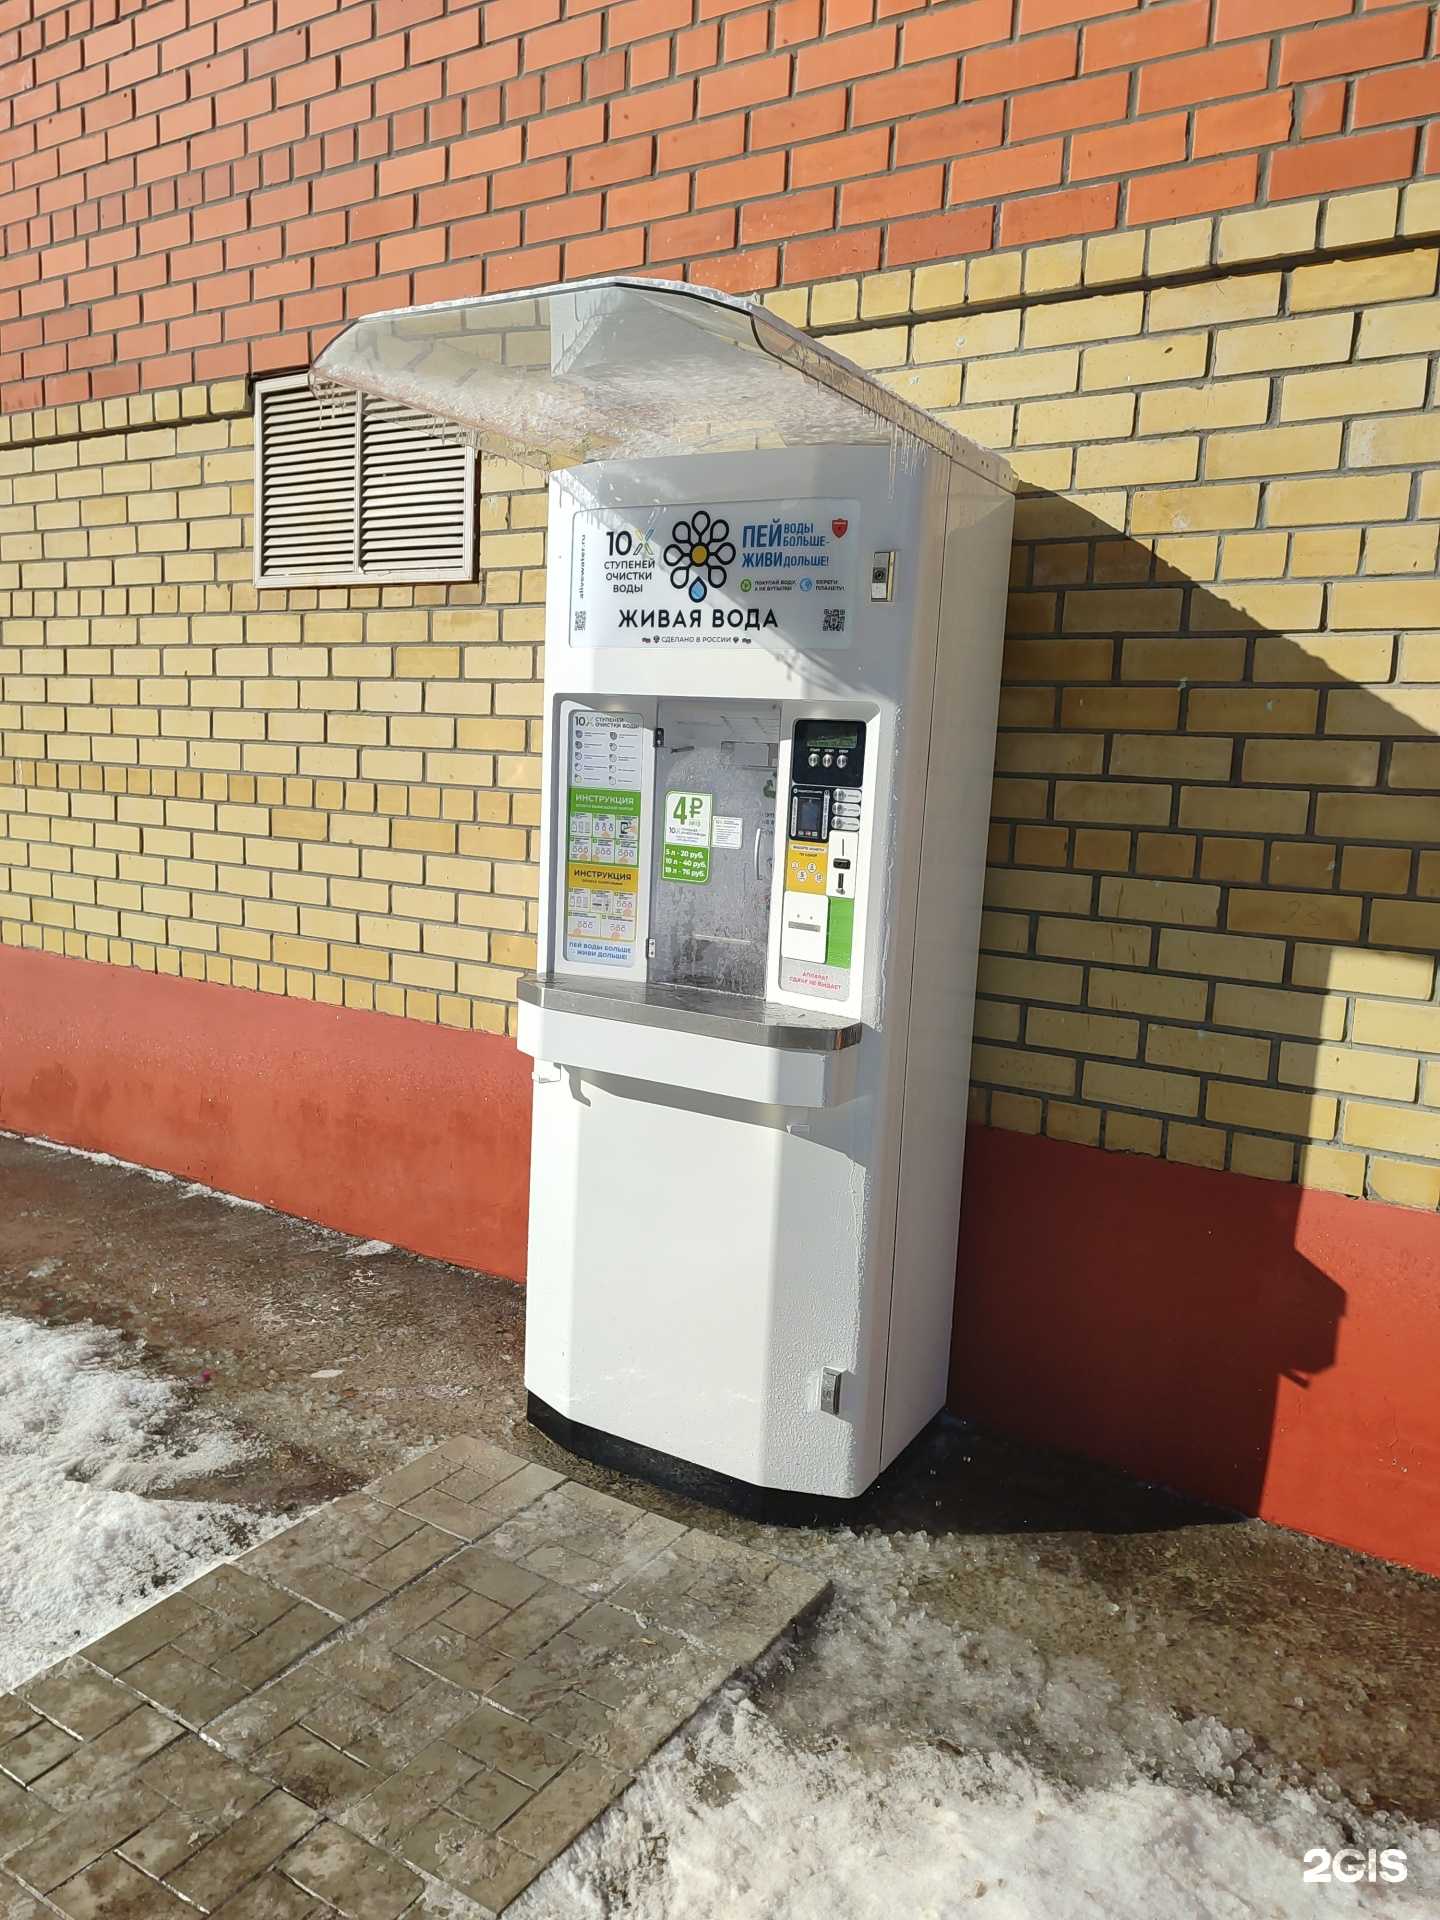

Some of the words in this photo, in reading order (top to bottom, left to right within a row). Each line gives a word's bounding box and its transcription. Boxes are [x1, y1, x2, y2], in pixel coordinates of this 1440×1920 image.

[742, 518, 782, 548] ПЕЙ
[783, 523, 814, 535] ВОДЫ
[603, 558, 655, 570] СТУПЕНЕЙ
[742, 552, 783, 568] ЖИВИ
[783, 556, 829, 568] ДОЛЬШЕ!
[605, 572, 652, 581] ОЧИСТКИ
[613, 584, 643, 593] ВОДЫ
[618, 609, 702, 628] ЖИВАЯ
[712, 608, 778, 631] ВОДА
[575, 793, 634, 805] ИНСТРУКЦИЯ
[574, 869, 632, 881] ИНСТРУКЦИЯ
